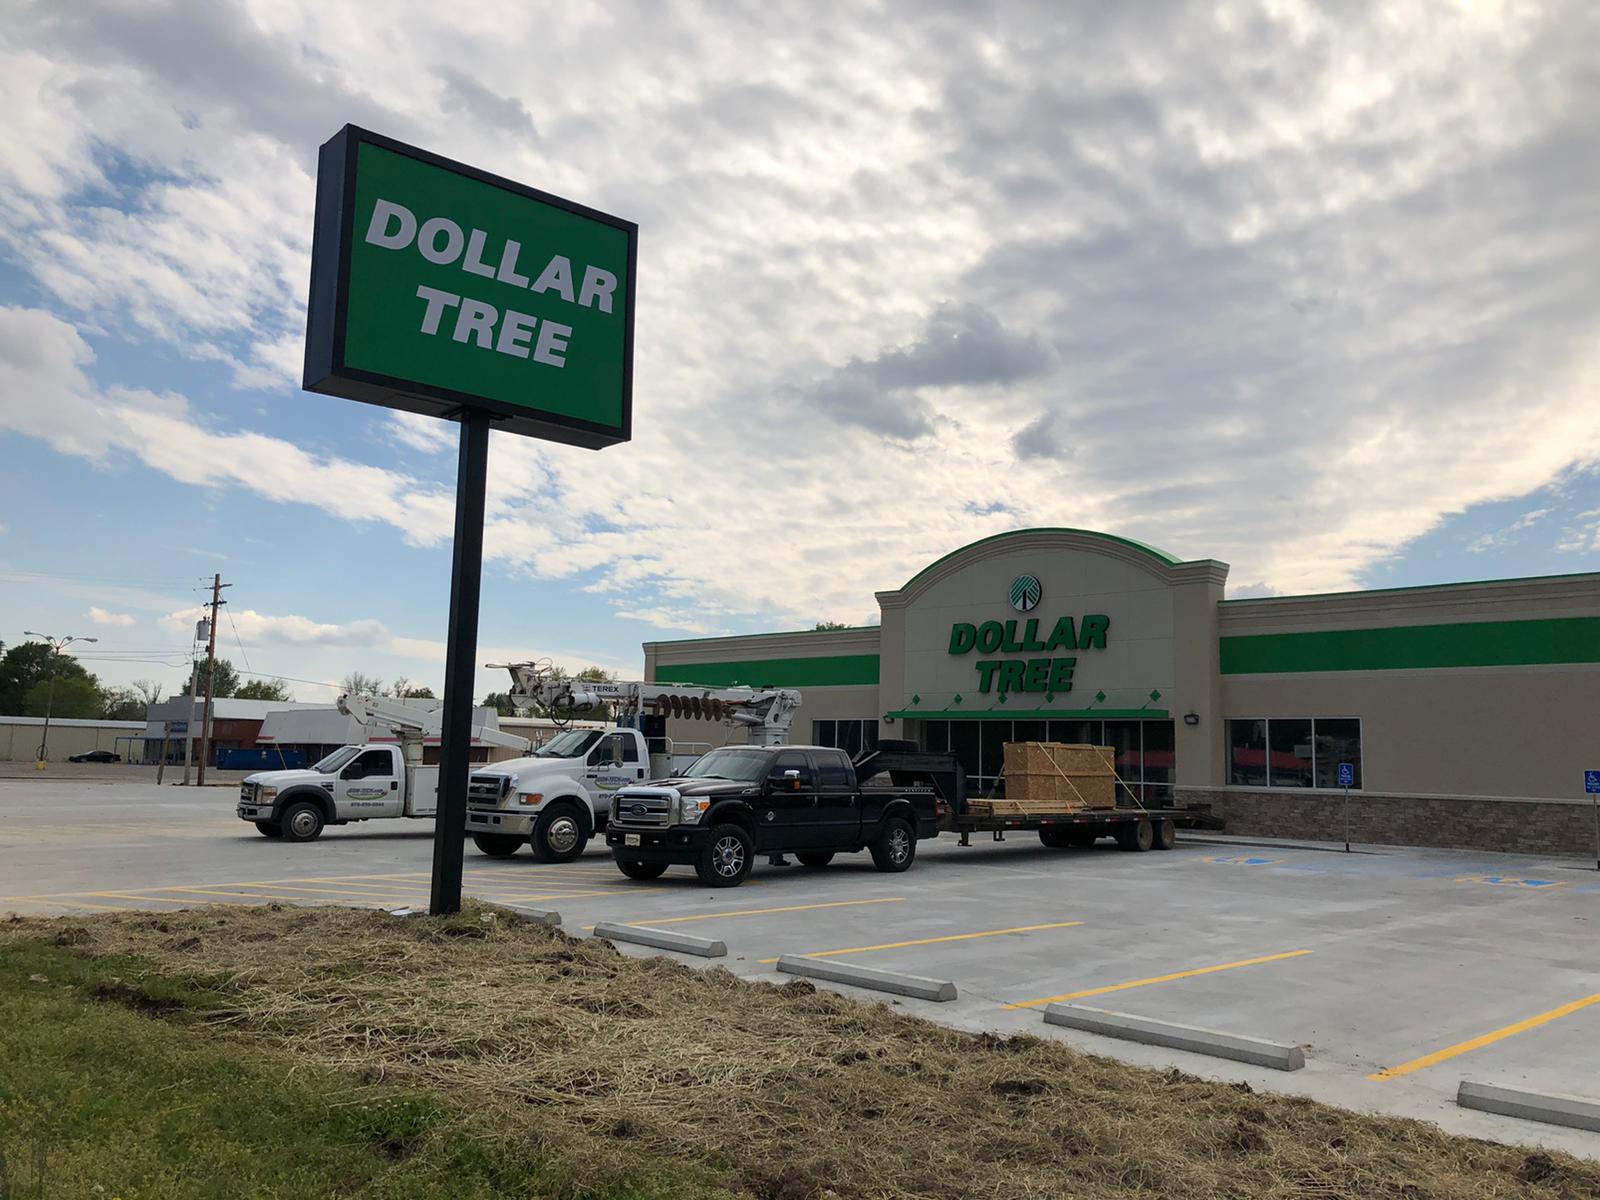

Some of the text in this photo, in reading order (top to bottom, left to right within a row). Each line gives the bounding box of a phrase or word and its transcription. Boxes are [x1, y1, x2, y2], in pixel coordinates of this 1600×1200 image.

[365, 199, 618, 314] DOLLAR
[416, 285, 573, 368] TREE
[948, 614, 1110, 655] DOLLAR
[592, 685, 619, 693] TEREX
[975, 657, 1077, 694] TREE
